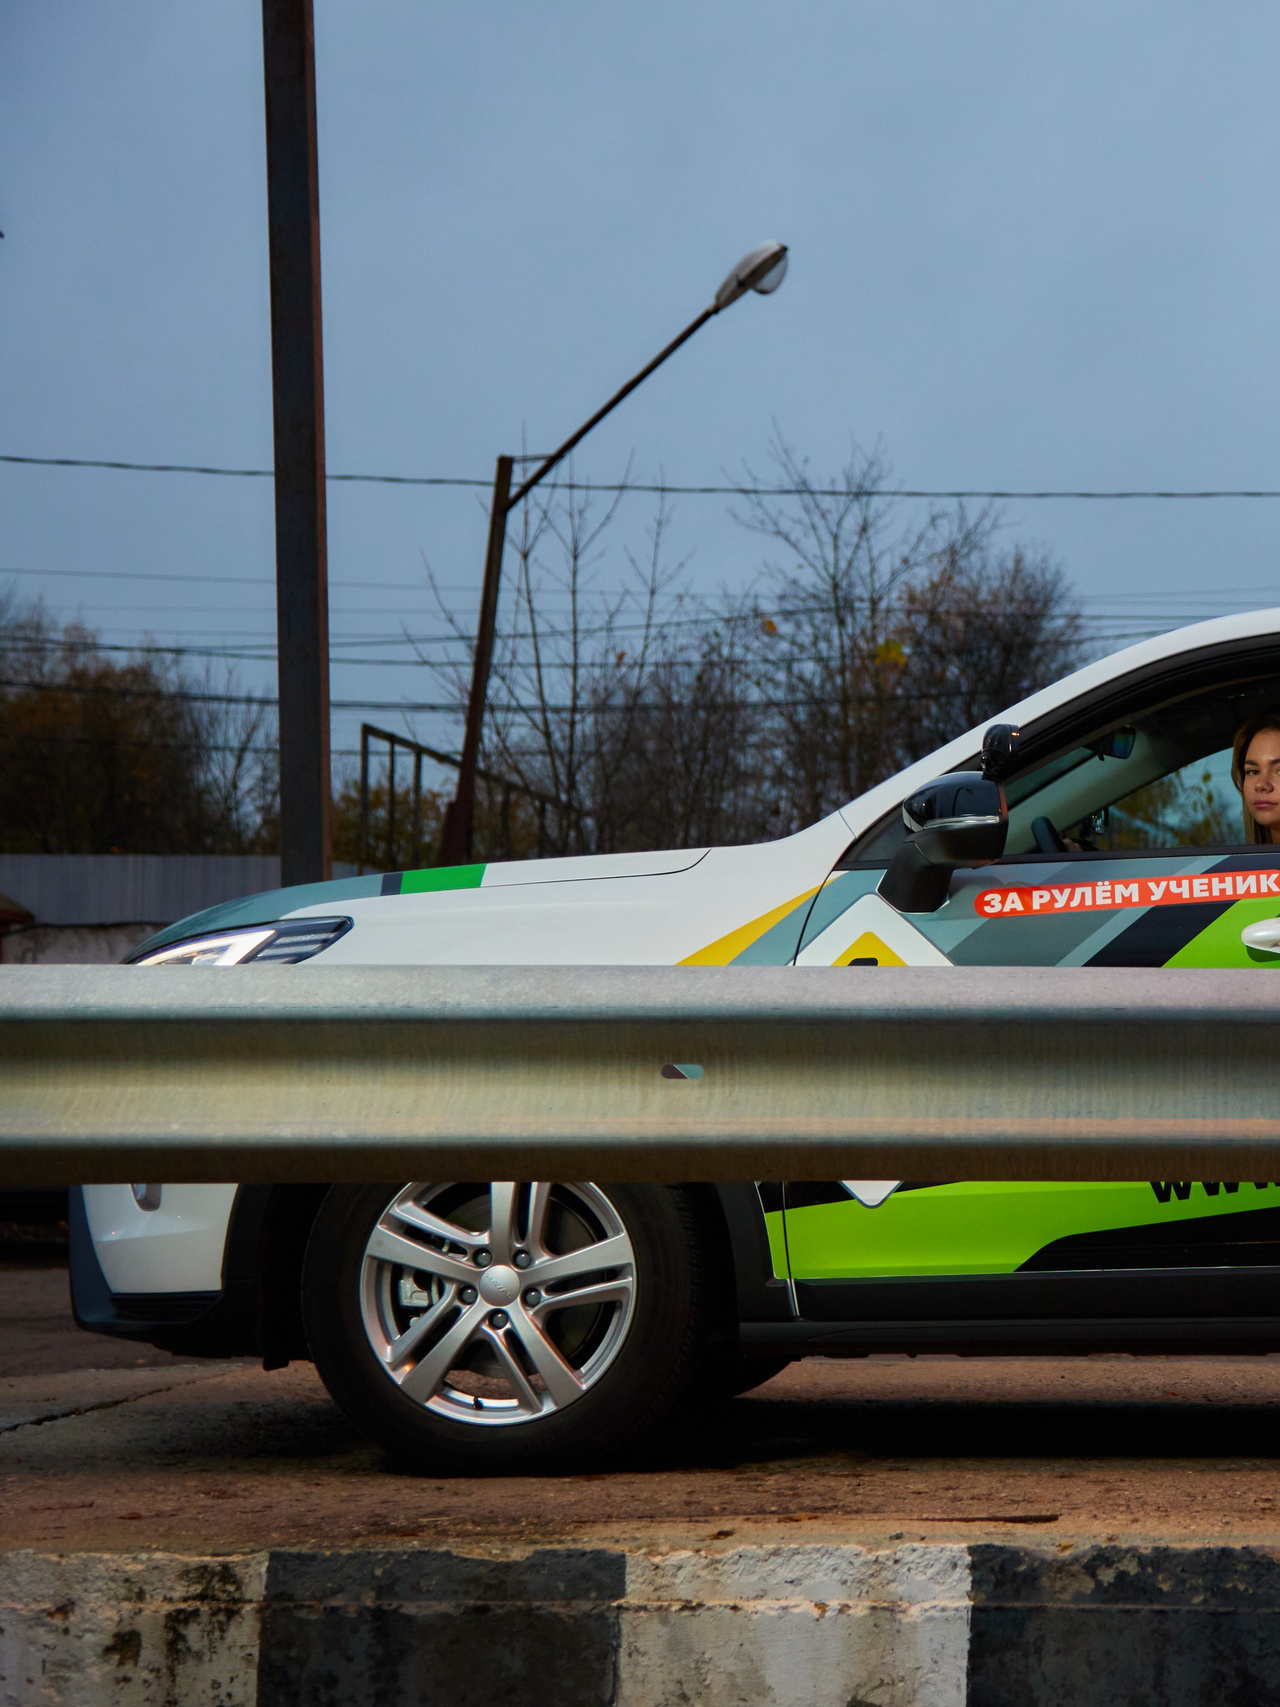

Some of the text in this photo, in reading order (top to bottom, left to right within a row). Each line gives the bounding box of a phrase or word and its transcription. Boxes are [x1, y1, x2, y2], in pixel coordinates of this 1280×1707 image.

[983, 873, 1280, 914] ЗА РУЛЁМ УЧЕНИК
